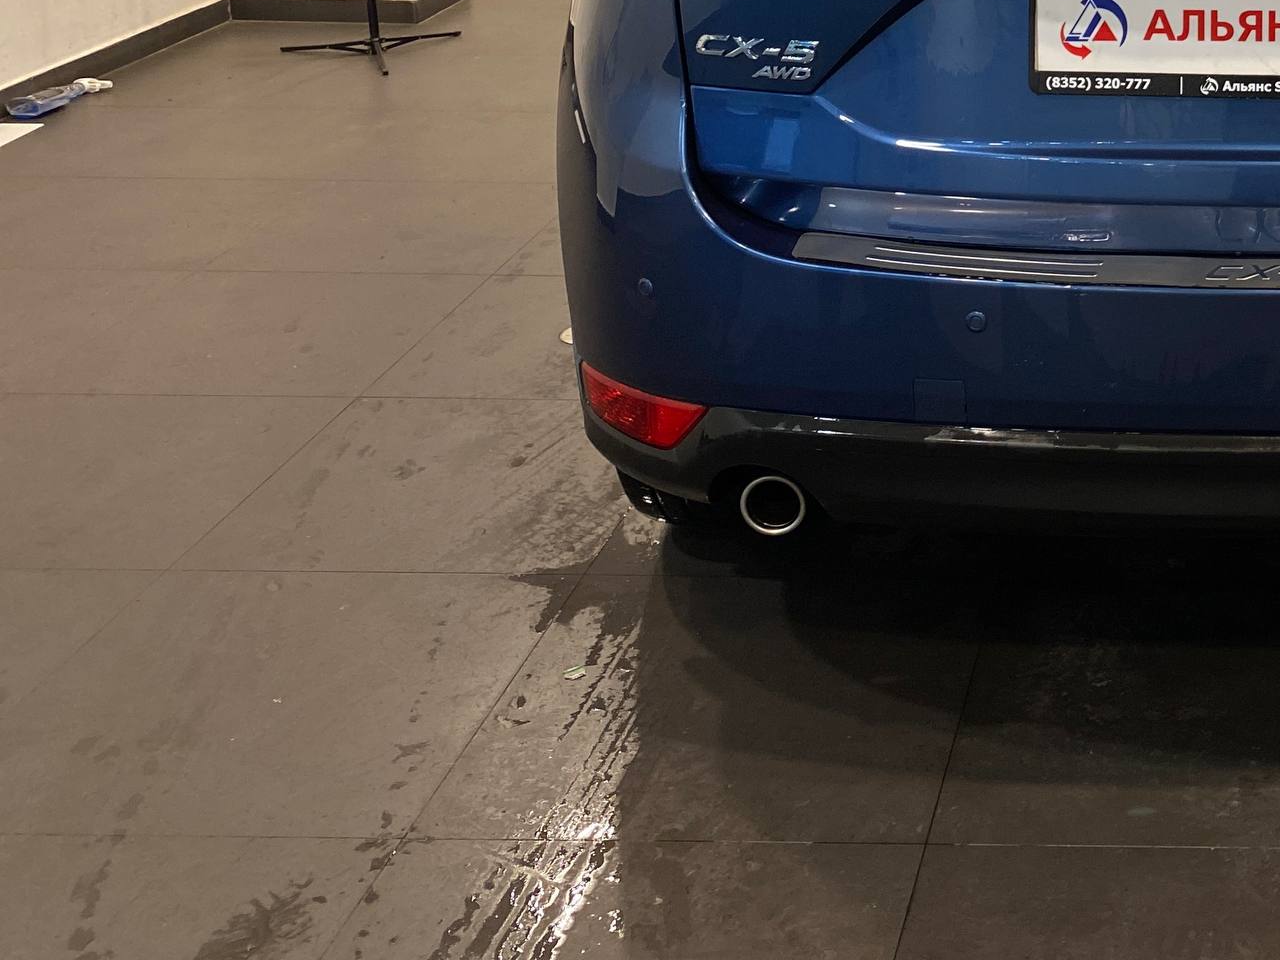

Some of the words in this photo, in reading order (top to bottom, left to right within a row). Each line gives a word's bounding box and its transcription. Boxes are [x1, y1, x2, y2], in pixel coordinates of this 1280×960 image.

[695, 34, 820, 64] CX-5
[752, 65, 811, 81] AWD
[1046, 76, 1091, 91] (8352)
[1095, 77, 1151, 91] 320-777
[1222, 80, 1272, 93] Альянс
